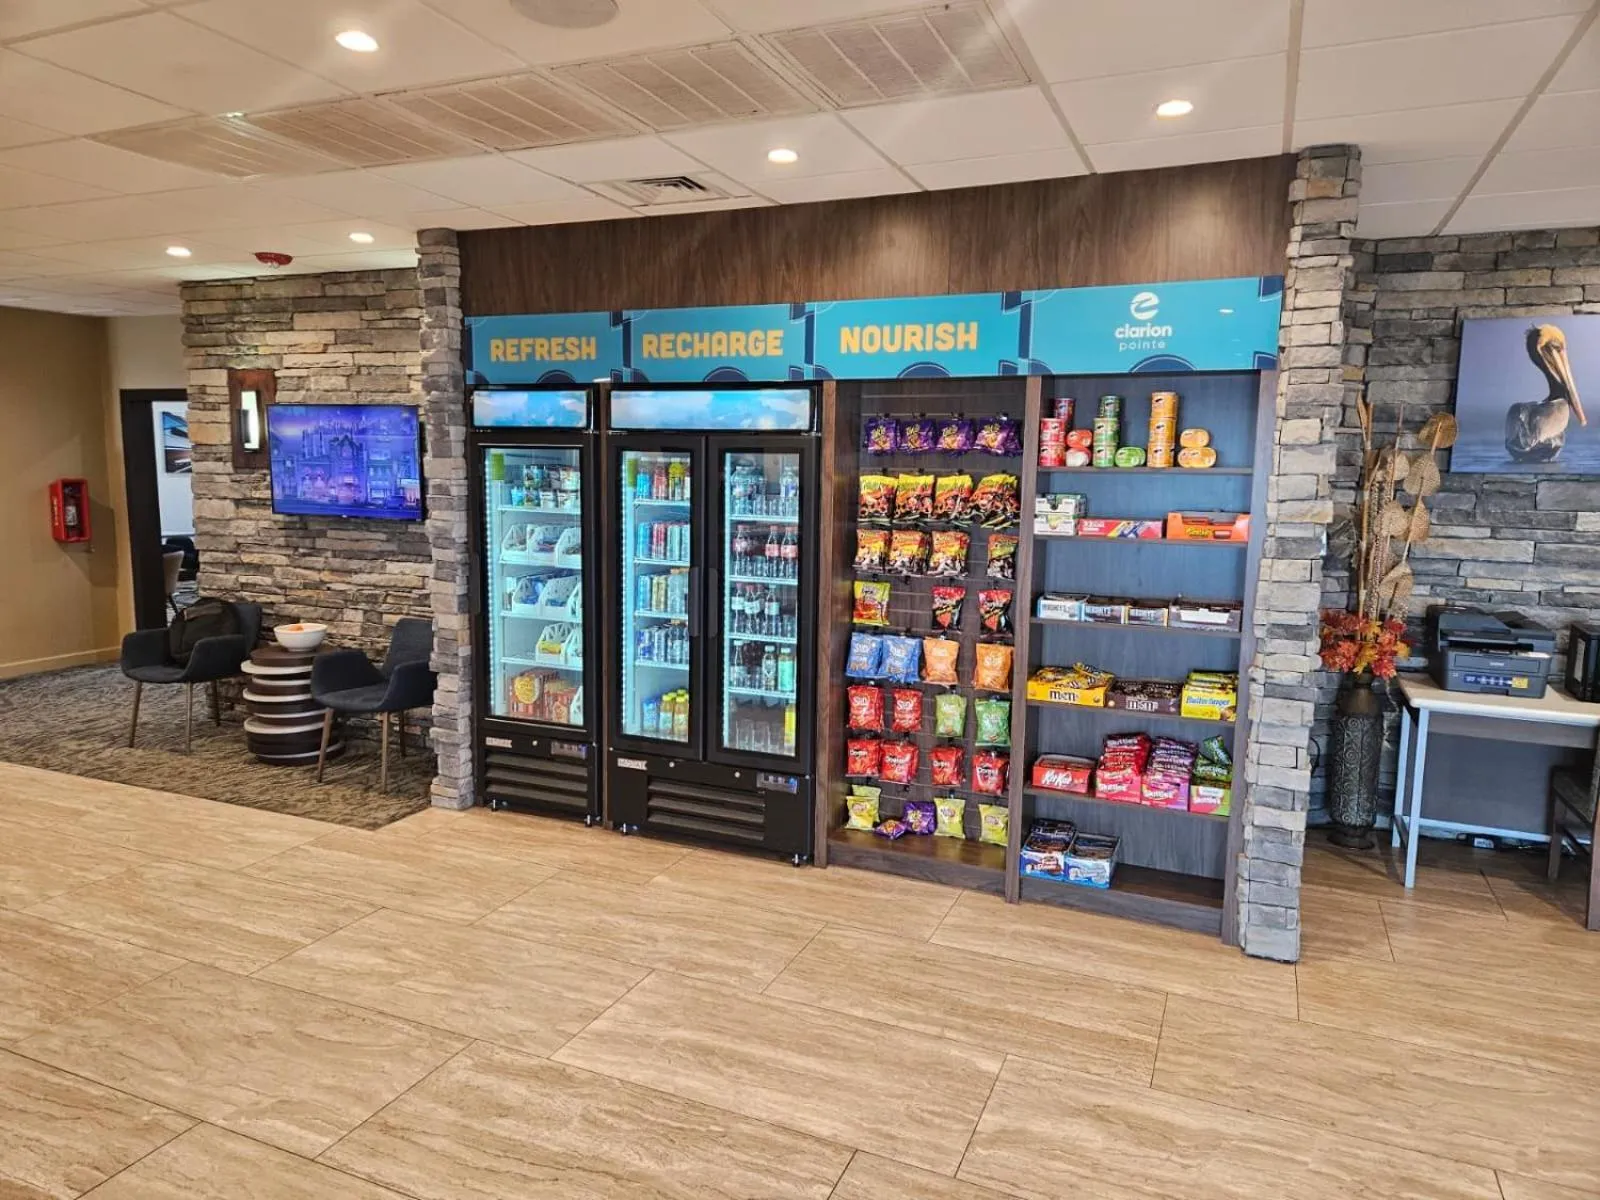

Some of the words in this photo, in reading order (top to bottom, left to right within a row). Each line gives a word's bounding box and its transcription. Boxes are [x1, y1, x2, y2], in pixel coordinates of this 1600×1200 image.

[839, 321, 979, 354] NOURISH
[1115, 322, 1173, 339] clarion
[490, 337, 597, 362] REFRESH
[642, 329, 784, 359] RECHARGE
[1119, 338, 1167, 352] pointe
